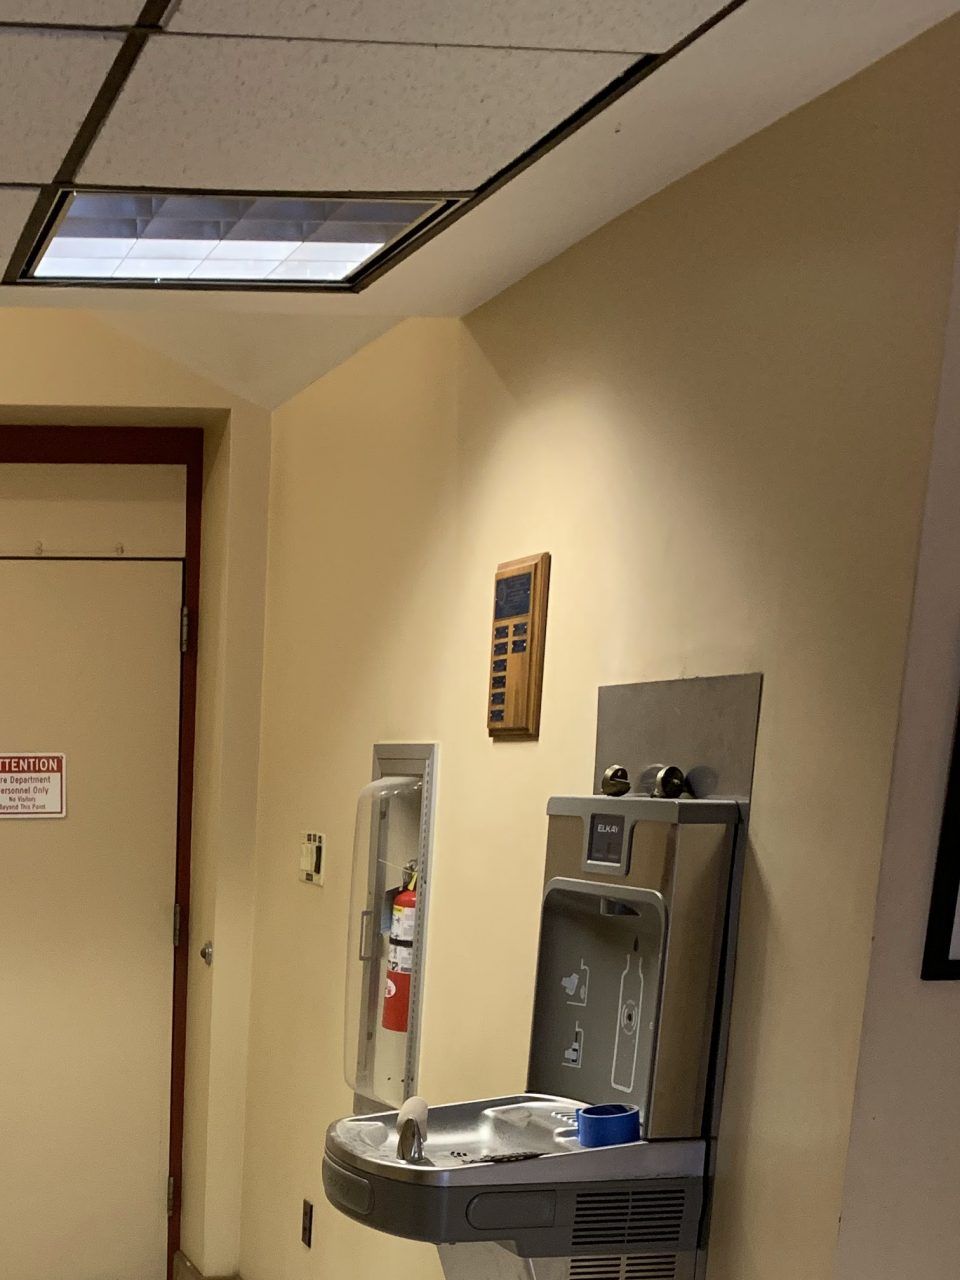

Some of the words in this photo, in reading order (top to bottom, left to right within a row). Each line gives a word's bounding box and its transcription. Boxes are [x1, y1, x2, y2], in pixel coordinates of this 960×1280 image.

[10, 776, 51, 785] Department
[33, 786, 49, 795] Only
[598, 824, 618, 833] ELKAY
